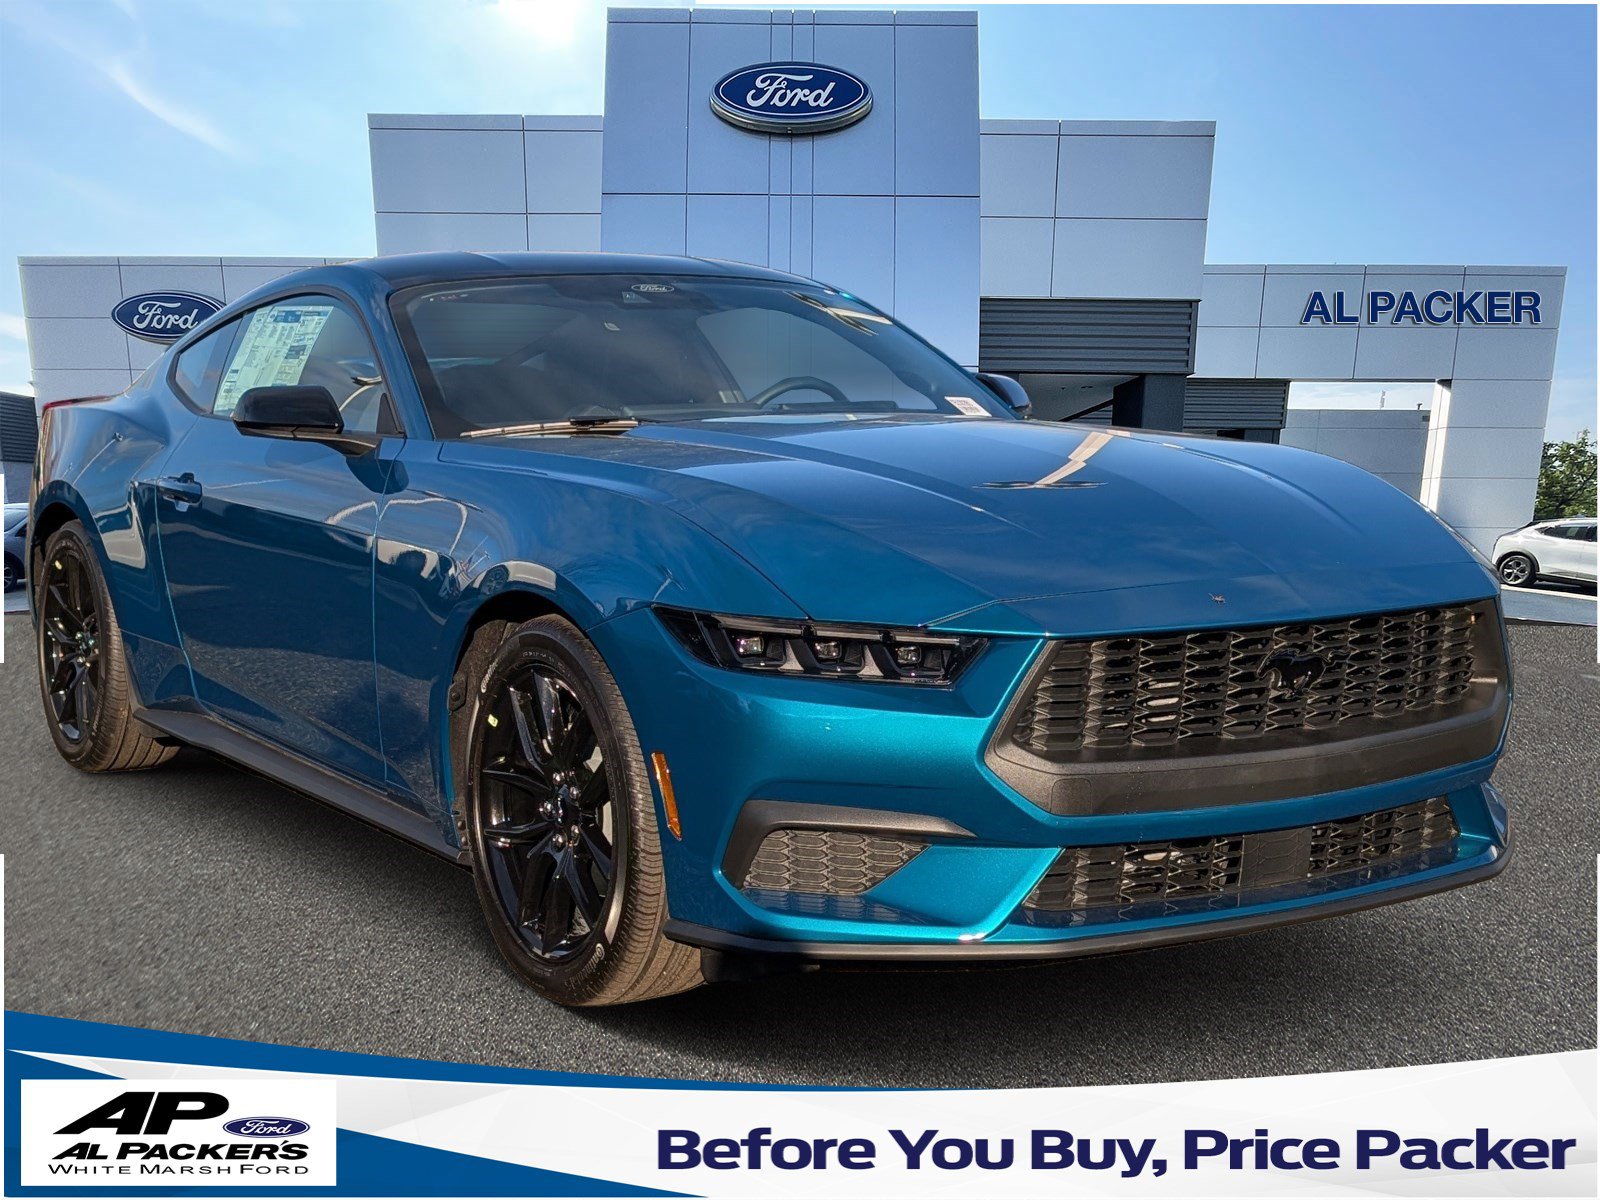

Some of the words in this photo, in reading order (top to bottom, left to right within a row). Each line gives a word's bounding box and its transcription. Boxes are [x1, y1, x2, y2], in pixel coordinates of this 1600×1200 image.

[746, 73, 836, 107] Ford
[133, 301, 199, 330] Ford
[1302, 290, 1360, 324] AL
[1367, 289, 1542, 325] PACKER
